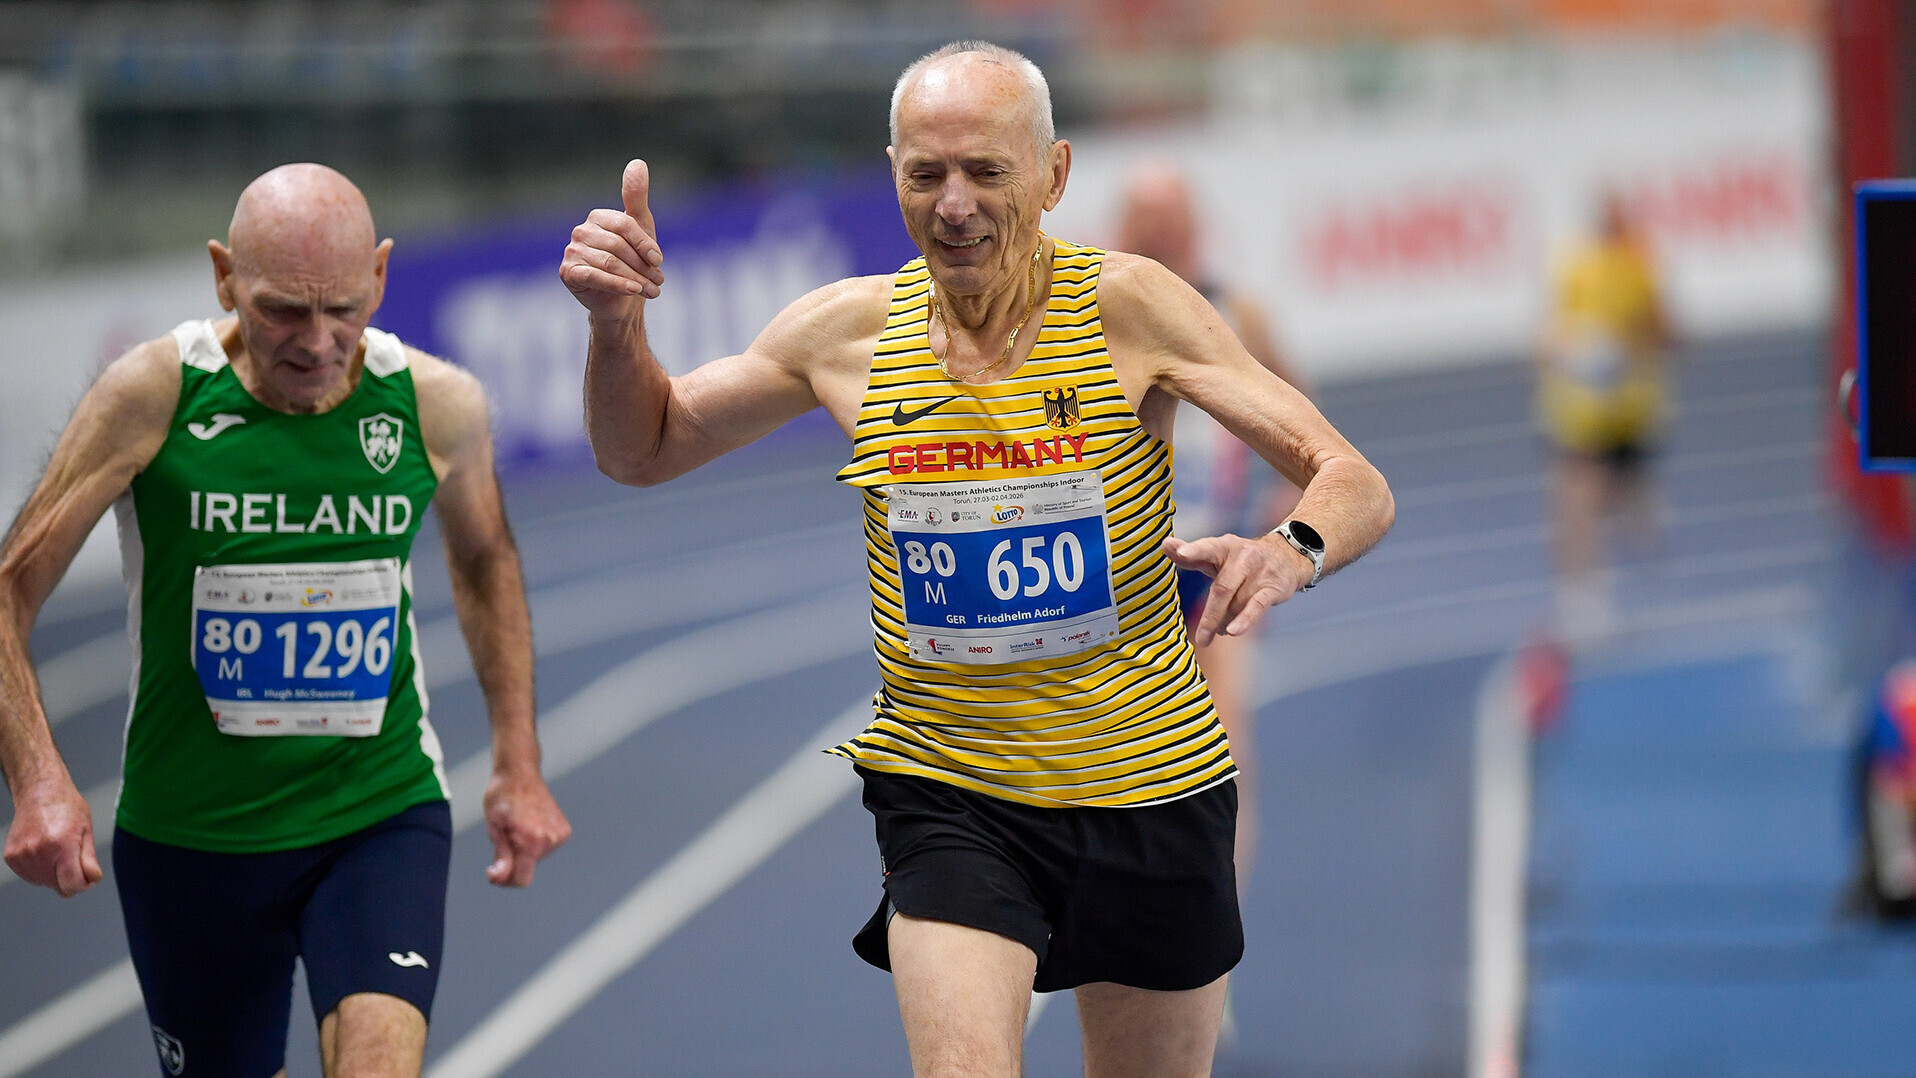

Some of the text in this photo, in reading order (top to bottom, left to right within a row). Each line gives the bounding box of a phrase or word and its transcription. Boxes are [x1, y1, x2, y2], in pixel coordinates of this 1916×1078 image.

[888, 432, 1089, 475] GERMANY
[909, 490, 939, 498] European
[940, 489, 968, 497] Masters
[969, 485, 1001, 495] Athletics
[1002, 480, 1059, 492] Championships
[1060, 477, 1084, 486] Indoor
[973, 493, 1024, 503] 27.03-02.04.2026
[190, 491, 412, 535] IRELAND
[997, 509, 1018, 521] LOTTO
[904, 540, 957, 577] 80
[987, 531, 1085, 601] 650
[924, 580, 947, 606] M
[946, 605, 1066, 624] GER Friedhelm Adorf
[203, 618, 262, 654] 80
[275, 616, 391, 679] 1296
[968, 646, 993, 654] ANIRO
[218, 657, 243, 681] M
